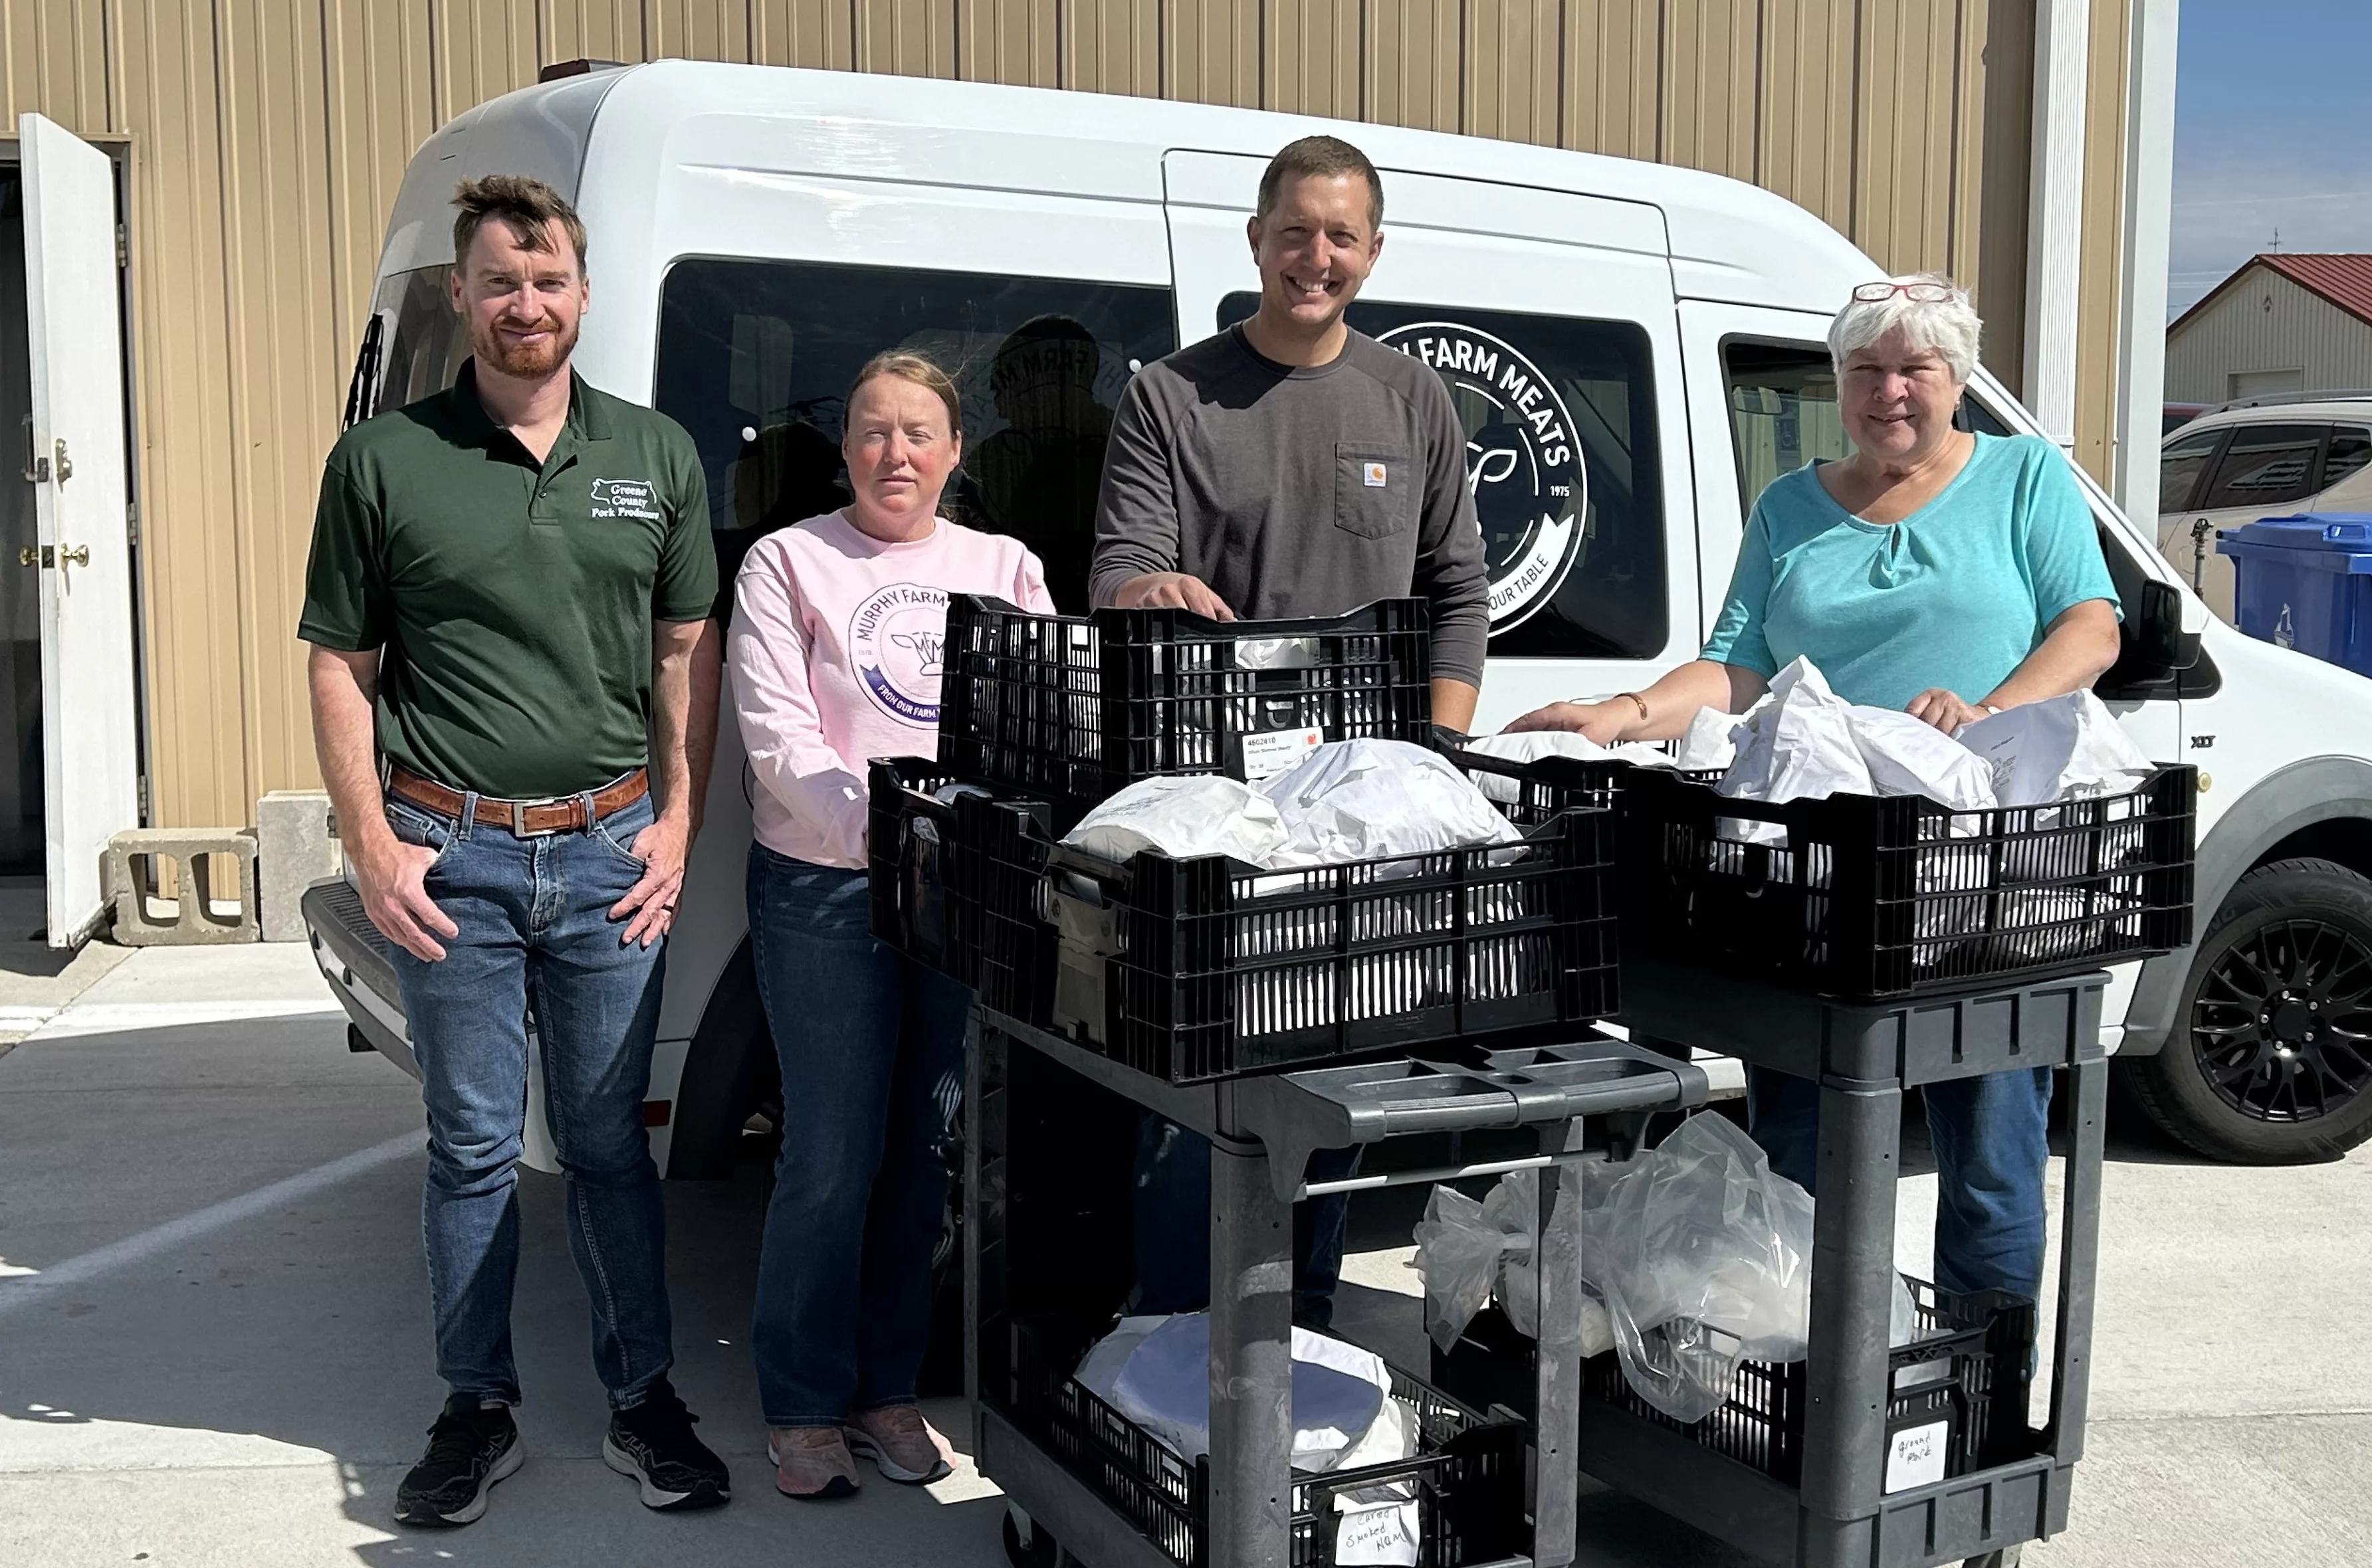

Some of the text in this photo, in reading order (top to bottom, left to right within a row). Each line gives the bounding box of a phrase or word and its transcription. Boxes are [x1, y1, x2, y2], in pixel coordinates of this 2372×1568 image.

[1418, 337, 1570, 467] FARM MEATS
[610, 484, 648, 496] Greene
[1550, 485, 1570, 497] 1975
[611, 496, 648, 508] County
[592, 507, 660, 520] Pork Producers
[1488, 553, 1549, 610] OUR TABLE
[857, 589, 945, 641] MURPHY FARM
[877, 684, 899, 705] FROM
[896, 700, 914, 714] OUR
[913, 707, 936, 718] FARM
[2191, 735, 2216, 749] XLT
[1346, 1521, 1386, 1547] Smoked
